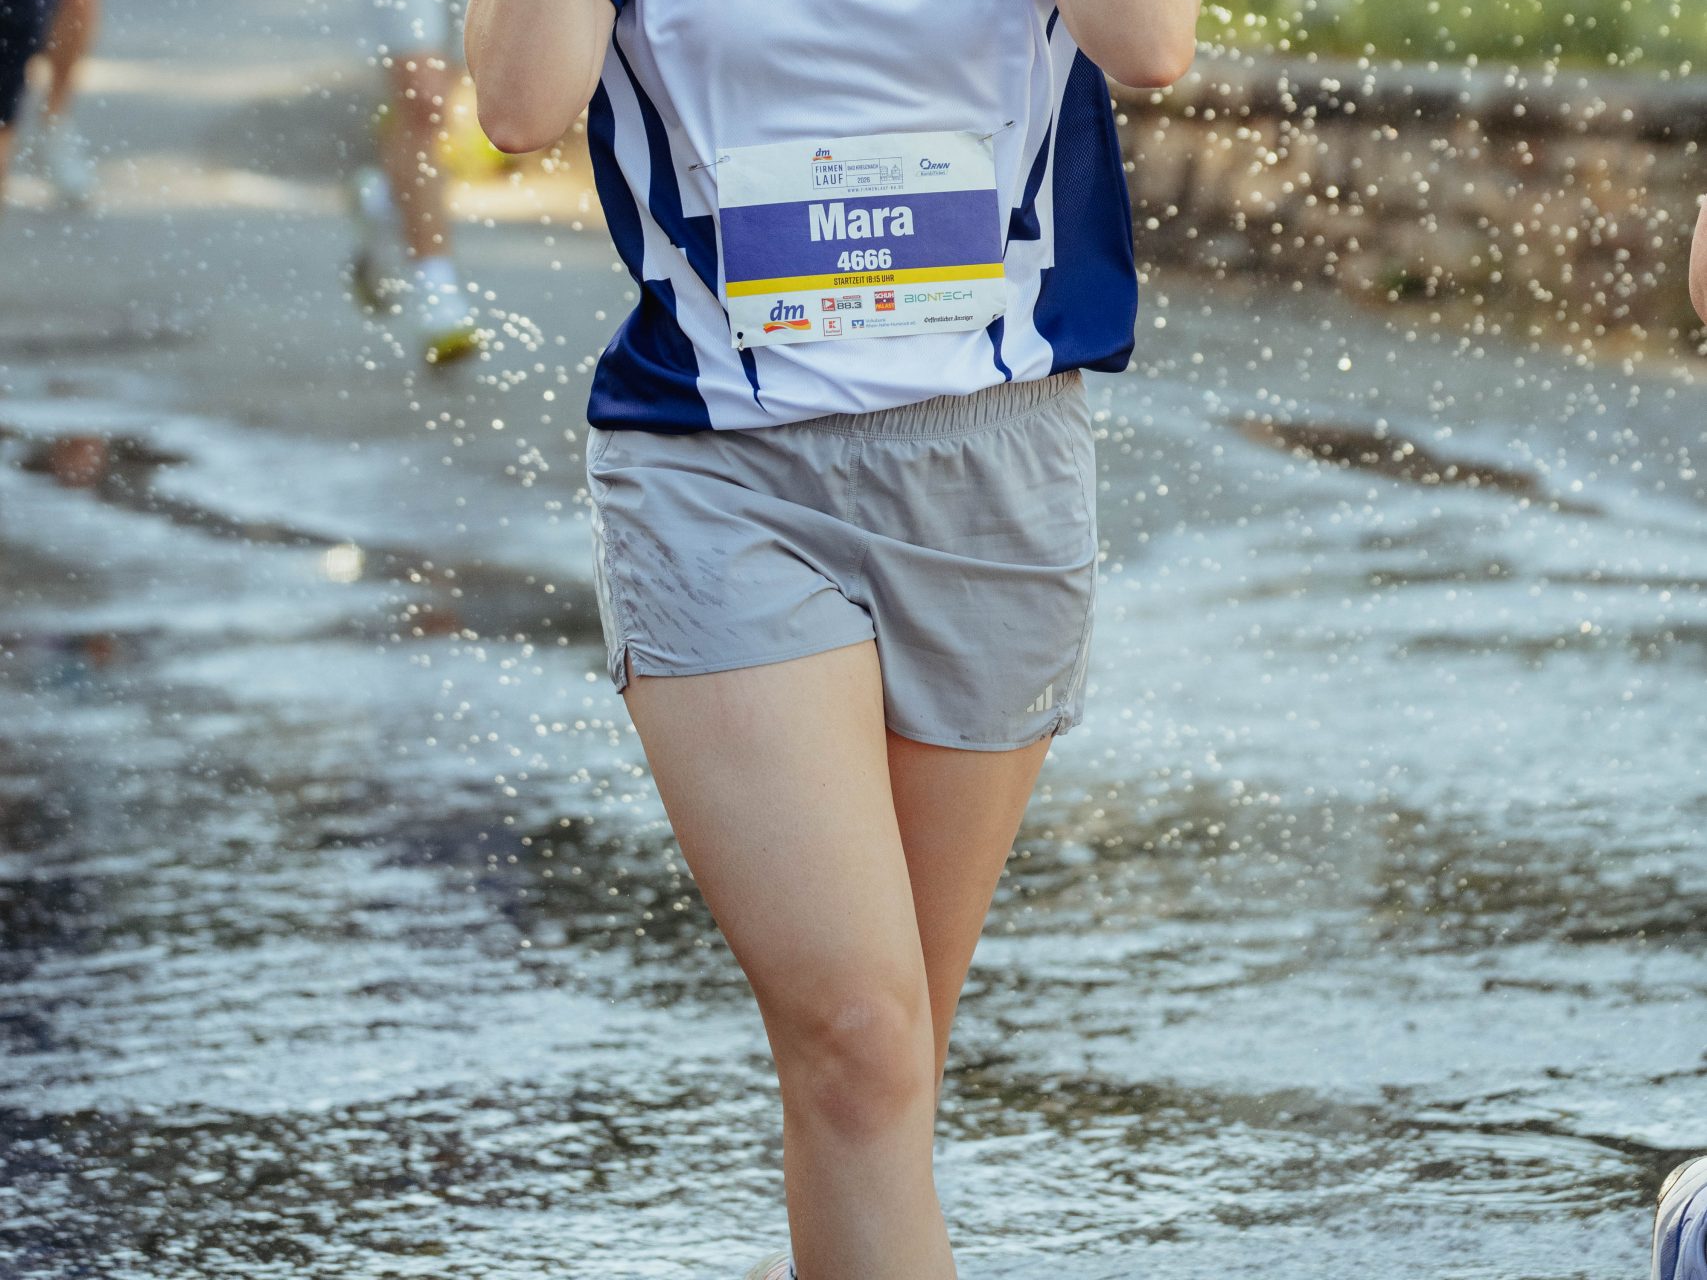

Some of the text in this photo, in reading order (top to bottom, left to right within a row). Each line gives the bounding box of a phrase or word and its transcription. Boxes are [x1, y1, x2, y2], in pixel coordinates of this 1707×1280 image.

[815, 148, 830, 157] dm
[815, 164, 843, 173] FIRMEN
[816, 173, 843, 185] LAUF
[808, 202, 915, 242] Mara
[837, 248, 892, 271] 4666
[834, 276, 865, 285] STARTZEIT
[881, 274, 895, 283] UHR
[904, 290, 973, 304] BIONTECH
[770, 299, 805, 322] dm
